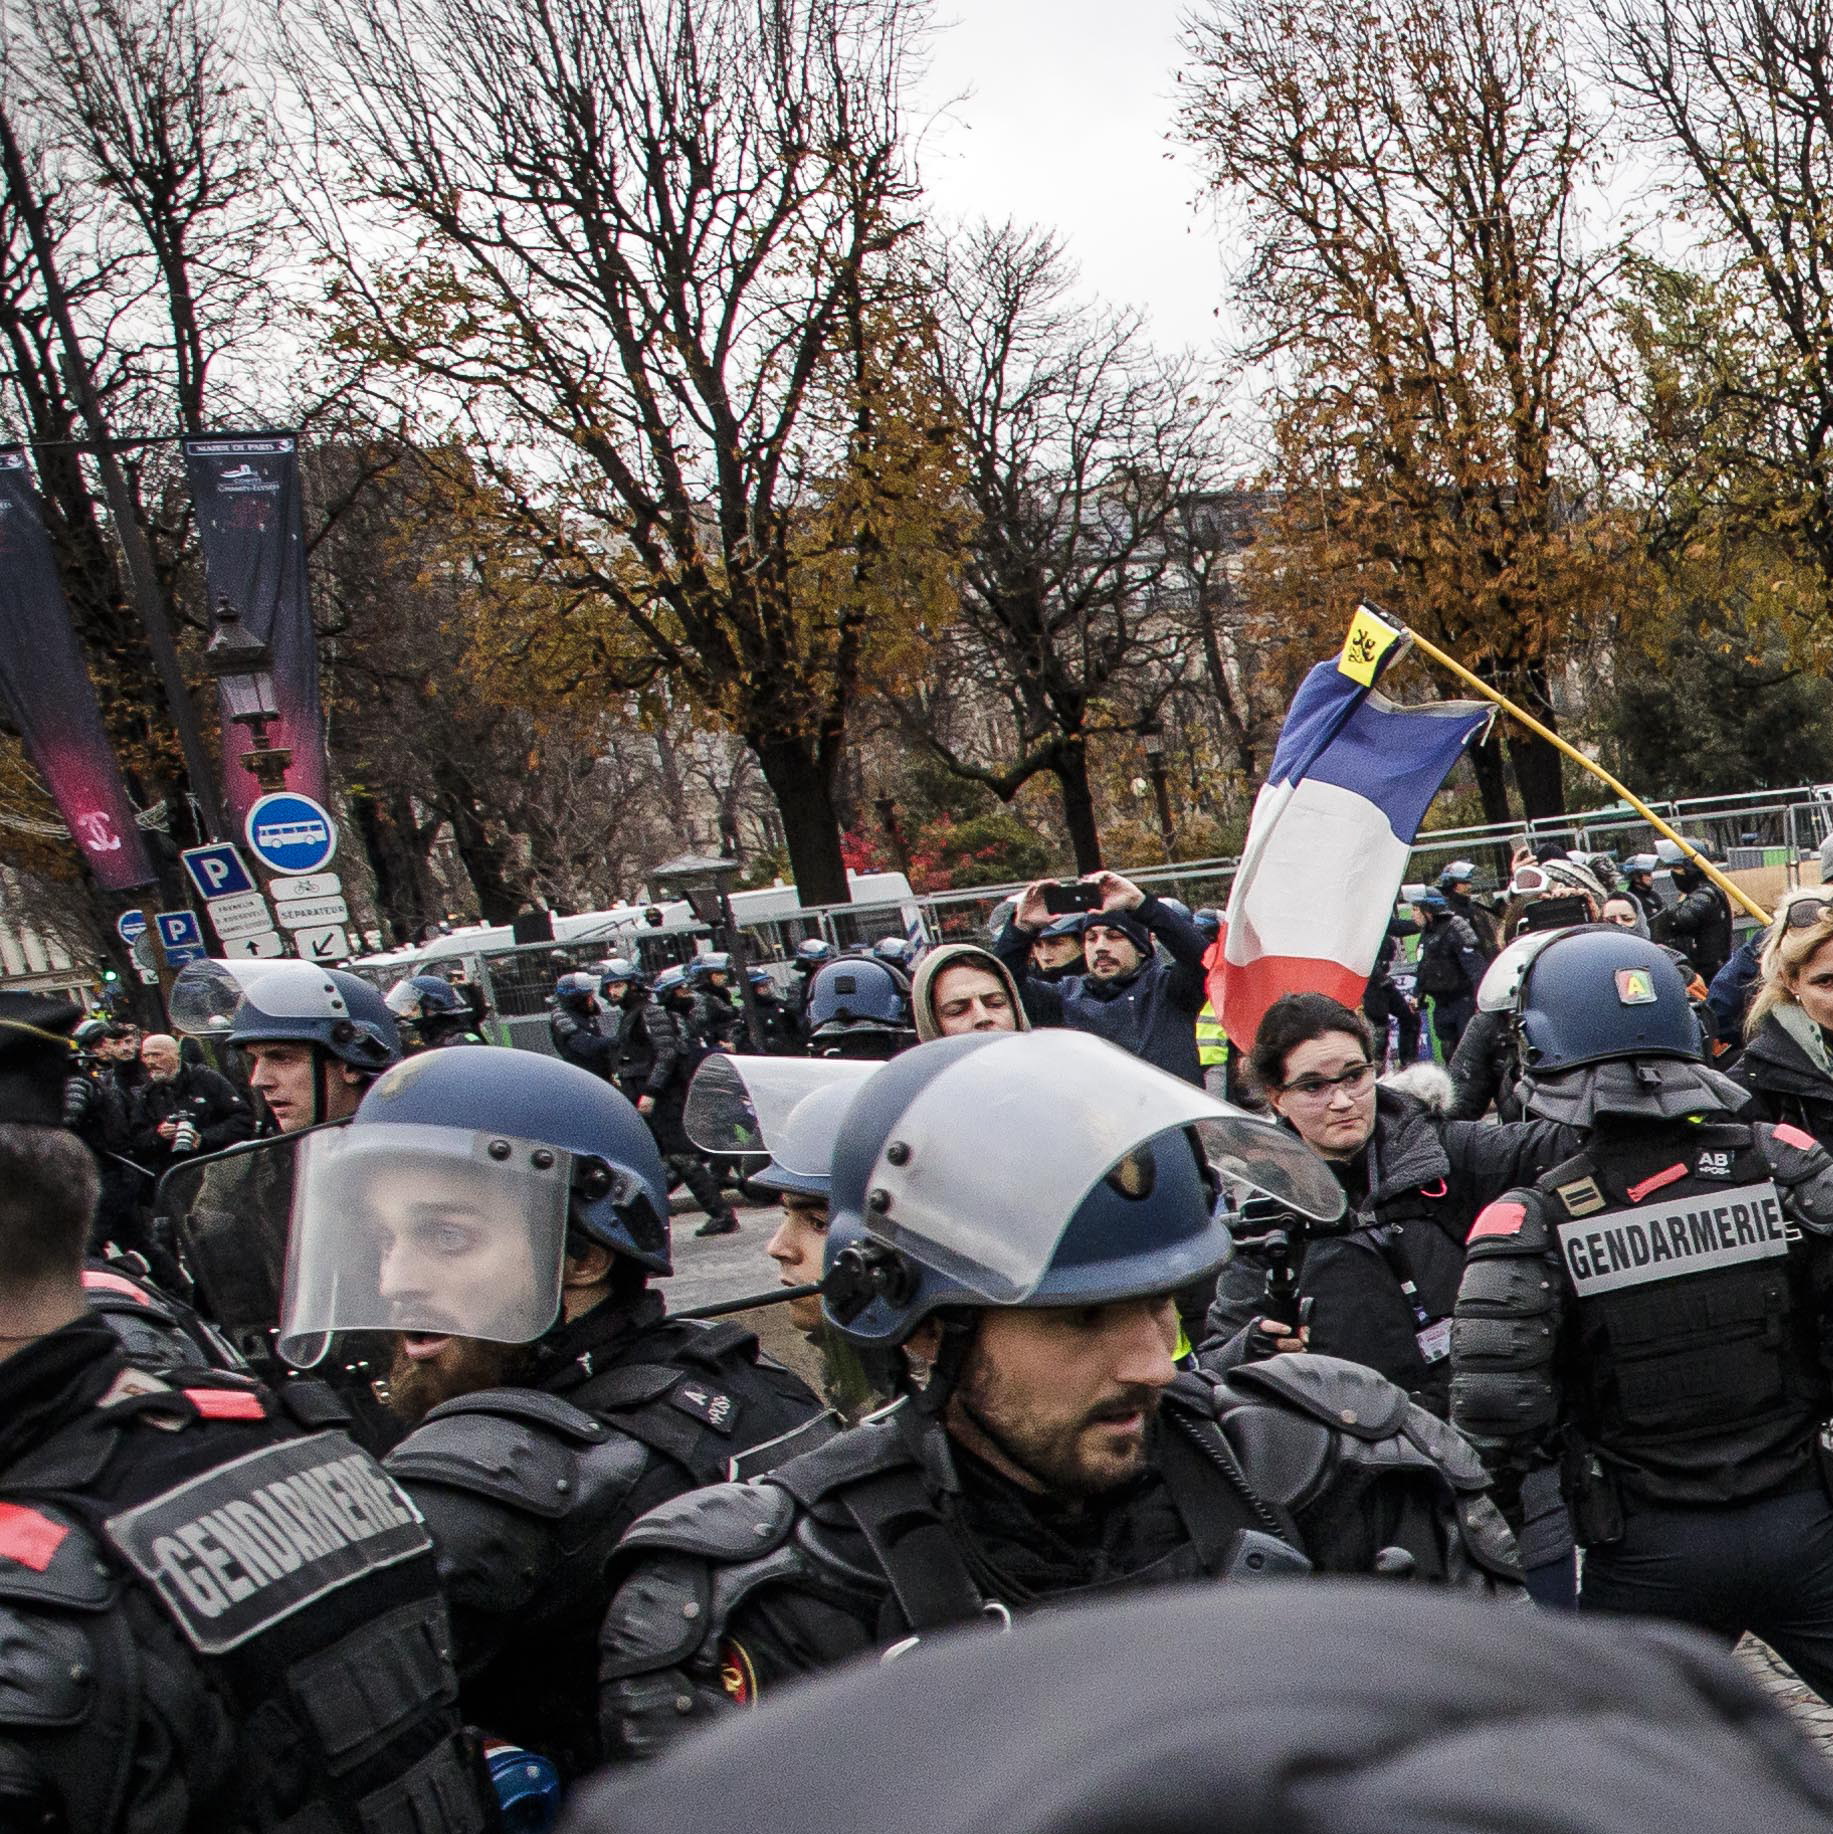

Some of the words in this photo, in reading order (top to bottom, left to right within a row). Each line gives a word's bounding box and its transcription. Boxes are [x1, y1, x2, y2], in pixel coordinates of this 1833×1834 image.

[201, 858, 229, 889] P
[168, 920, 187, 941] P
[1627, 975, 1646, 996] A
[1699, 1152, 1729, 1168] AB
[1567, 1198, 1784, 1280] GENDARMERIE
[684, 1389, 708, 1407] A
[151, 1453, 415, 1620] GENDARMERIE
